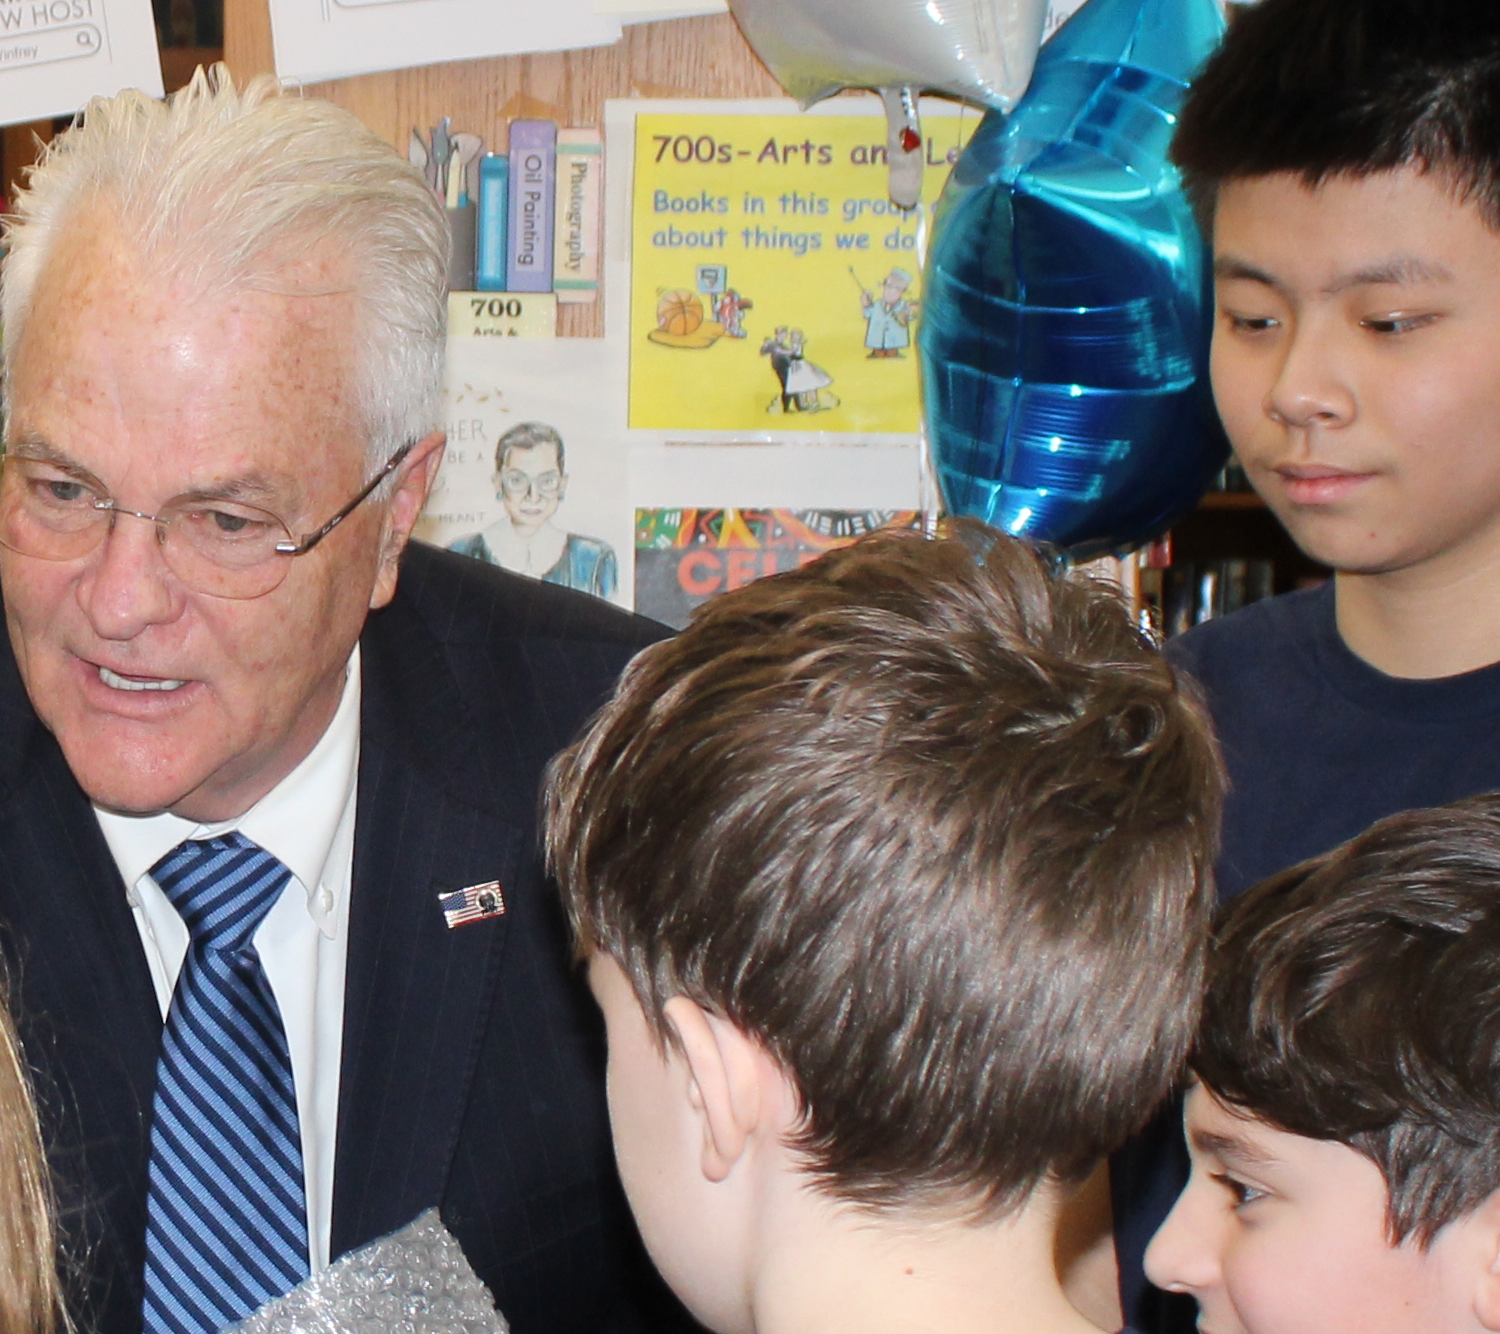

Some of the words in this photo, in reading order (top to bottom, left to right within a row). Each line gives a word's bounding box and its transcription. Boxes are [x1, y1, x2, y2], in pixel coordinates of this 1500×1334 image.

[850, 145, 889, 165] an
[927, 138, 961, 166] Le
[524, 154, 542, 184] Oil
[564, 159, 588, 272] Photography
[653, 189, 729, 214] Books
[743, 191, 766, 214] in
[779, 190, 829, 216] this
[518, 190, 541, 266] Painting
[653, 224, 728, 249] about
[741, 225, 822, 256] things
[836, 232, 870, 249] we
[471, 298, 522, 318] 700
